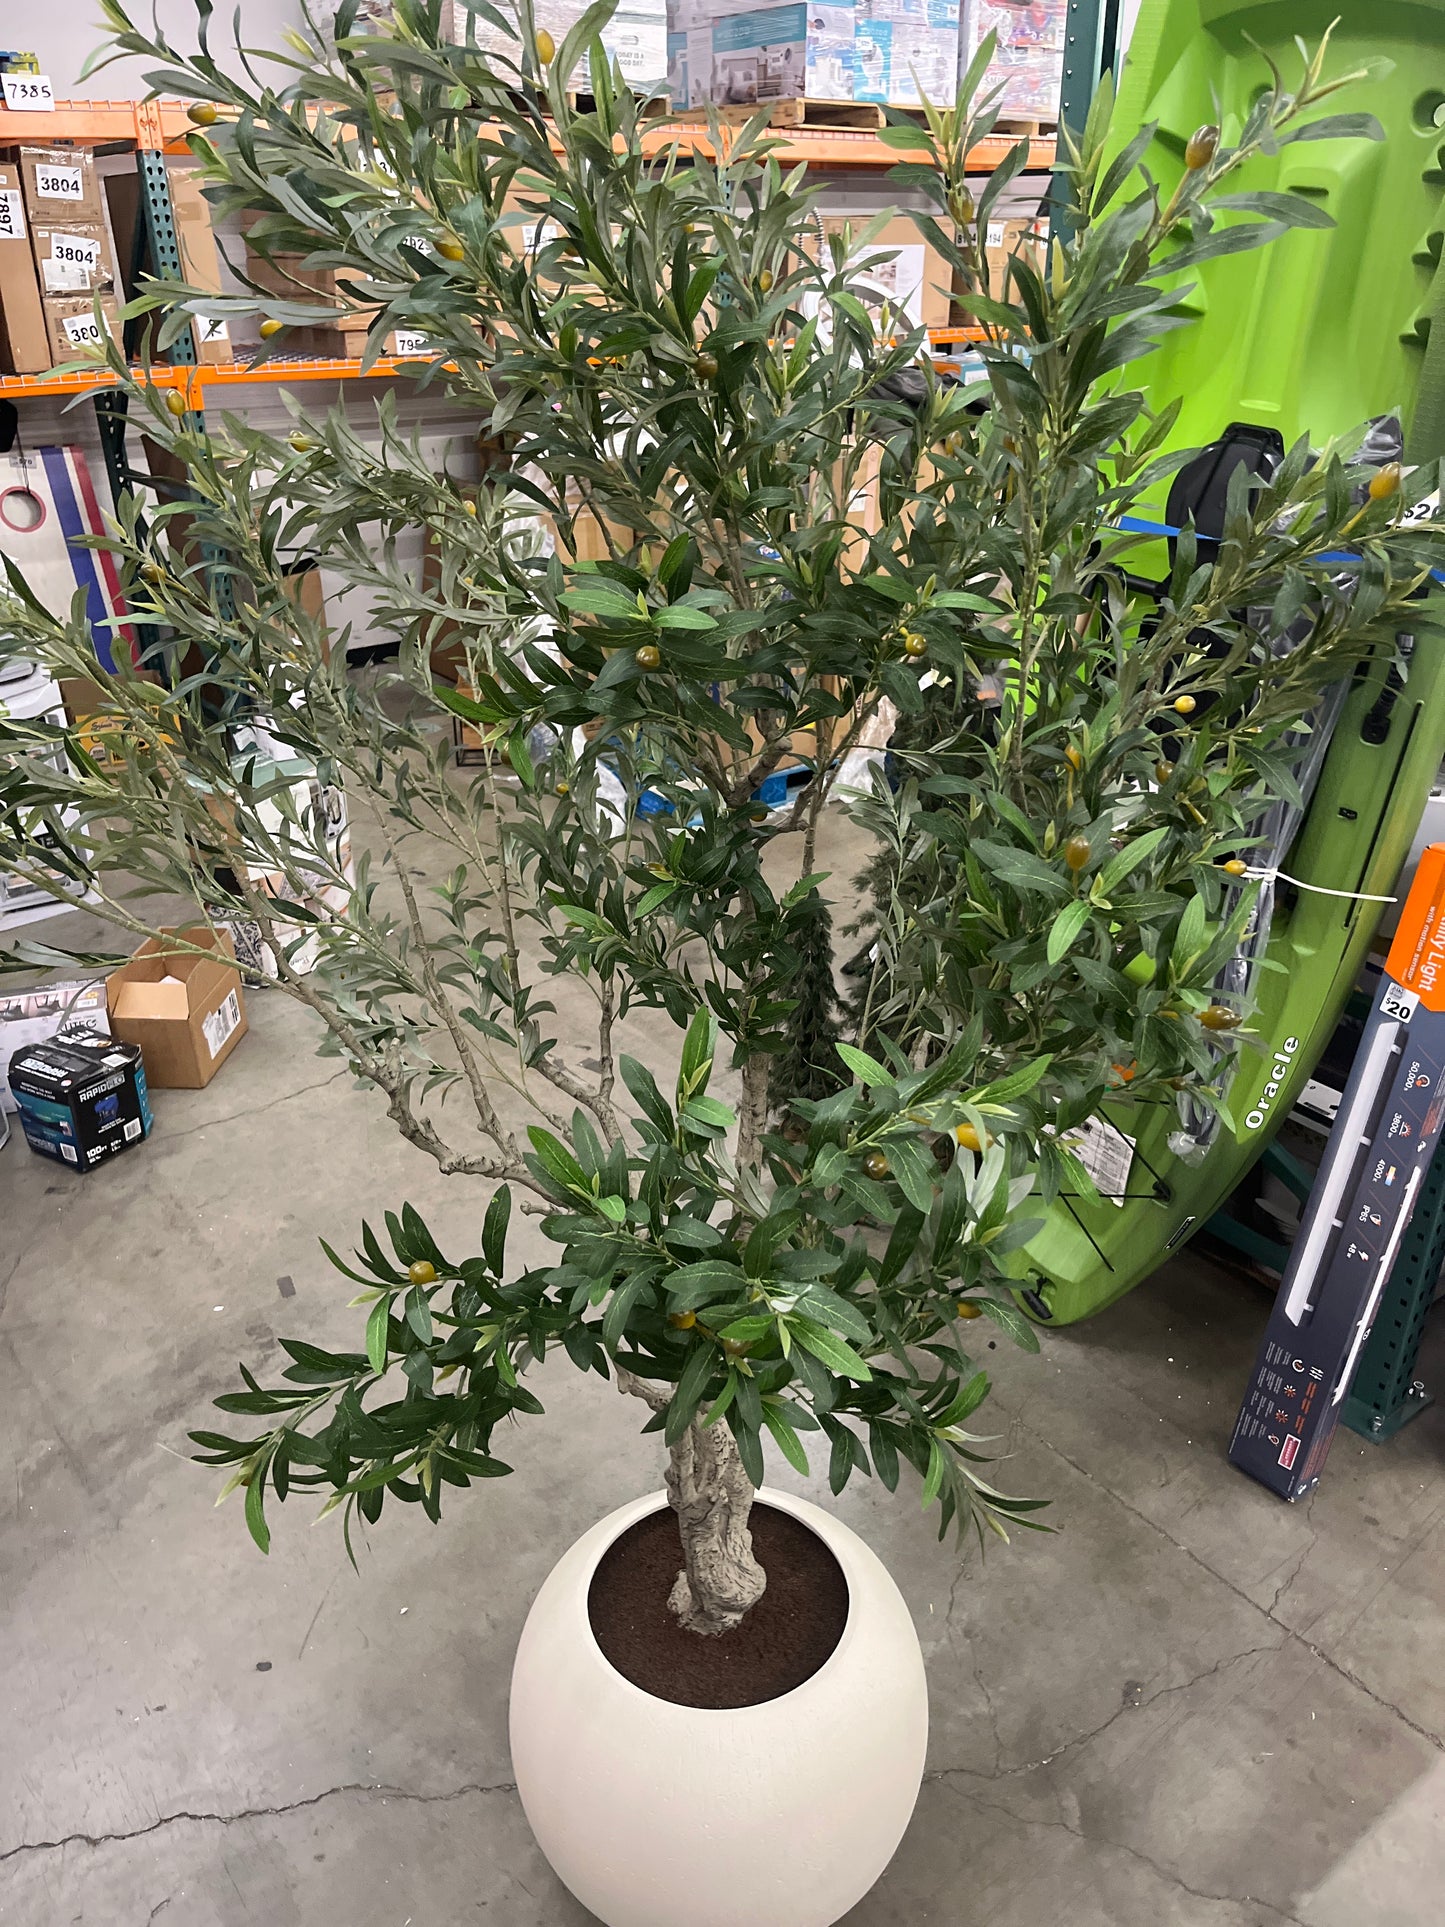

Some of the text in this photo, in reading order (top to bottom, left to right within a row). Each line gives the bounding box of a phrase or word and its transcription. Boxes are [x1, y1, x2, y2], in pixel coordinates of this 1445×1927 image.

[8, 83, 51, 99] 7385
[41, 177, 80, 193] 3804
[0, 193, 13, 235] 7897
[56, 246, 94, 264] 3804
[71, 325, 100, 342] 380
[1407, 906, 1436, 981] with motion sensor
[1418, 951, 1445, 991] Light
[1385, 997, 1411, 1019] $20
[1245, 1036, 1299, 1129] Oracle
